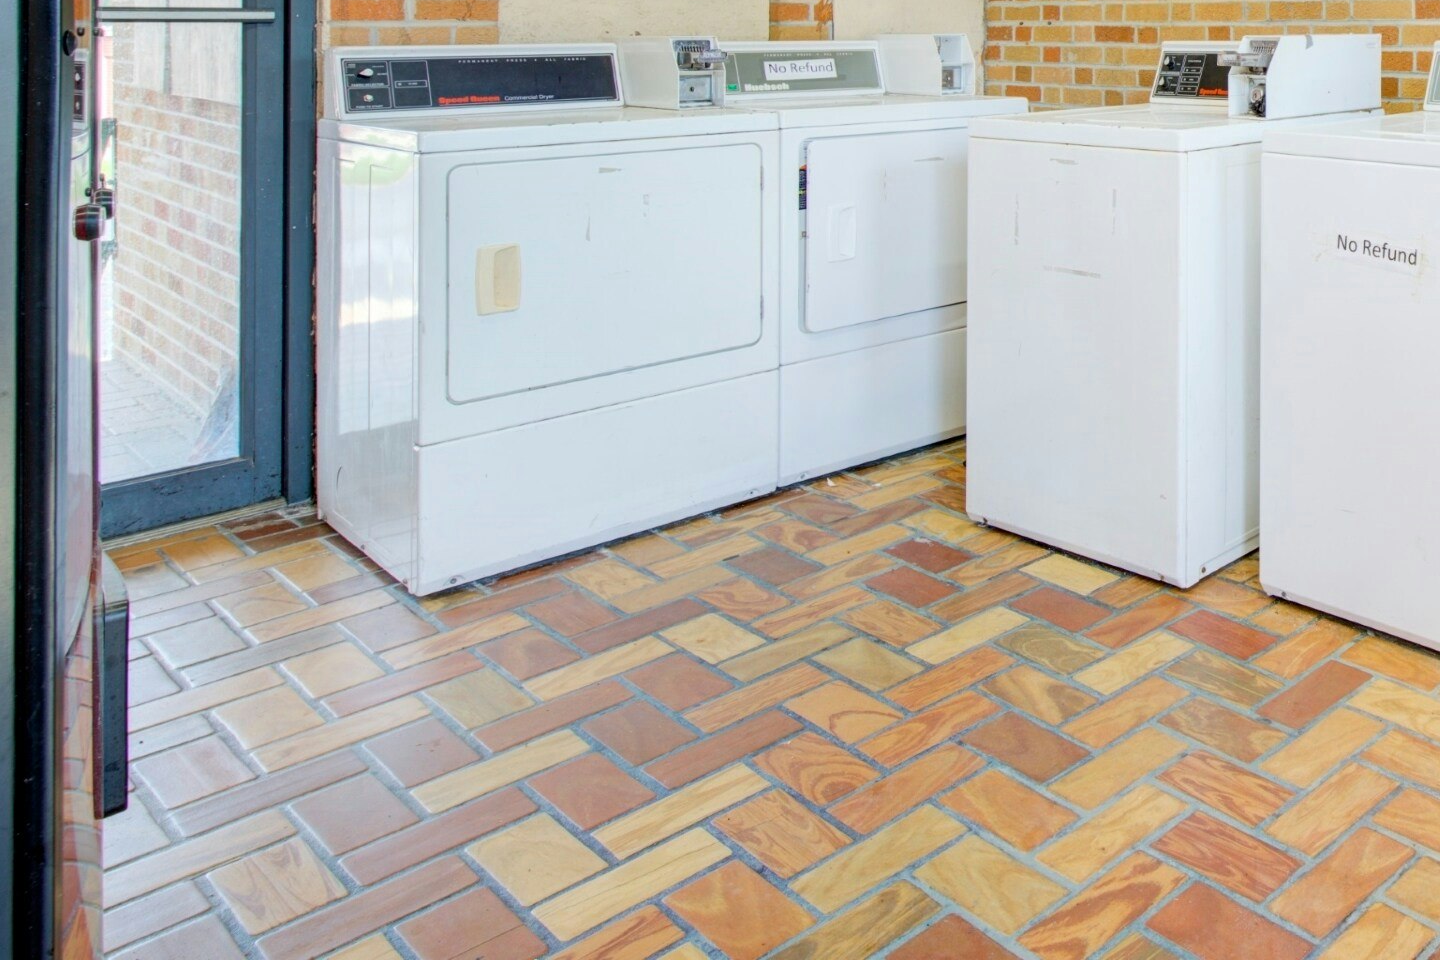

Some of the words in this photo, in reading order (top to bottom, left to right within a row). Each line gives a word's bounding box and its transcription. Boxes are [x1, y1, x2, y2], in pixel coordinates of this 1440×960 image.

[768, 62, 787, 74] No
[790, 61, 834, 74] Refund
[744, 82, 790, 91] Huebsch
[437, 96, 469, 105] Speed
[470, 94, 501, 103] Queen
[503, 94, 538, 102] Commercial
[539, 93, 555, 102] Dryer
[1336, 234, 1358, 253] No
[1362, 239, 1418, 266] Refund
